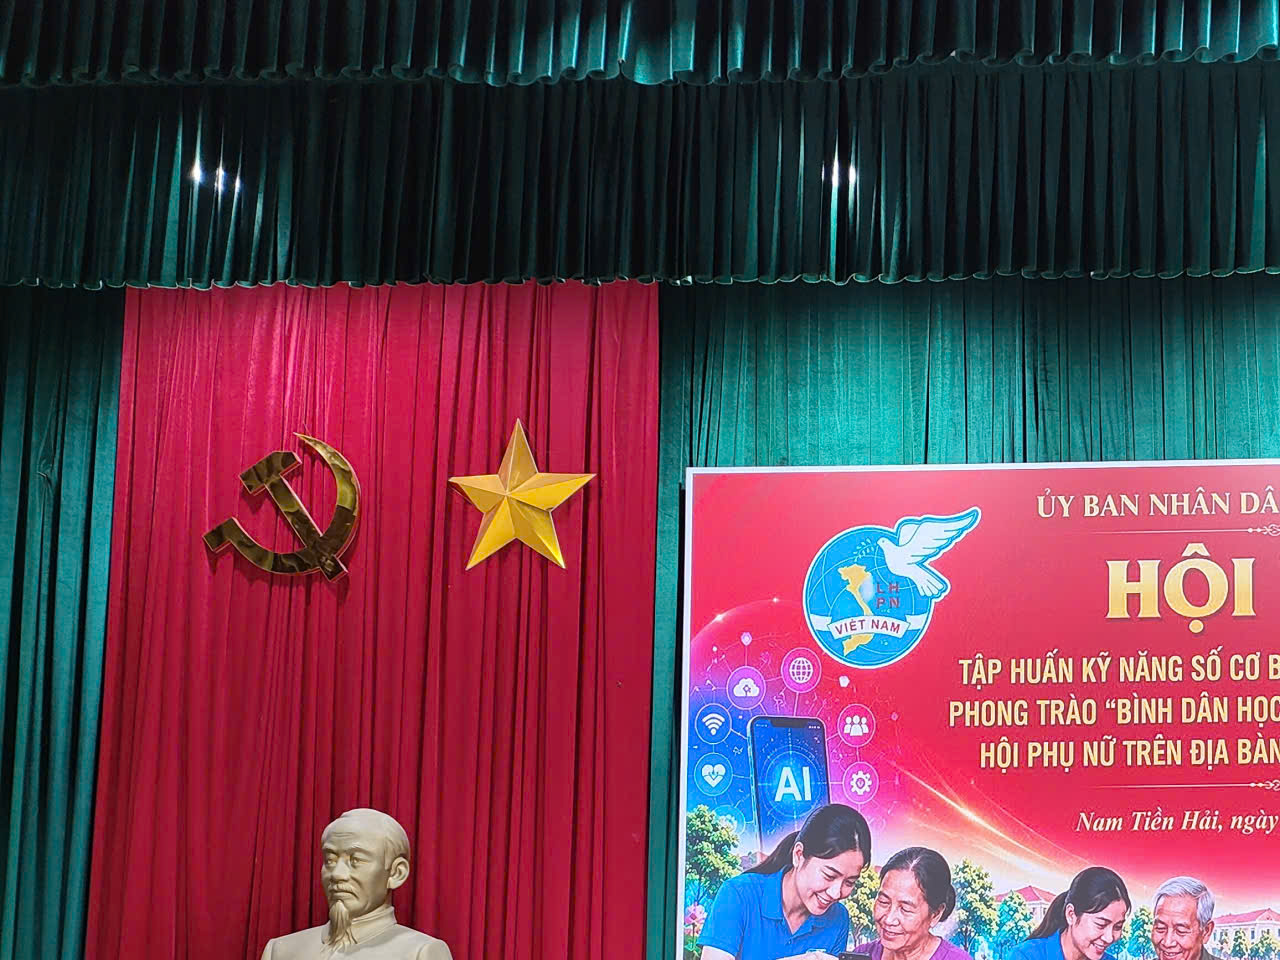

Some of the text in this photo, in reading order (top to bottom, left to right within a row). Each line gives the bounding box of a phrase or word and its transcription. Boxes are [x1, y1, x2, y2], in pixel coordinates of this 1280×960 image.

[1037, 487, 1075, 518] ỦY
[1083, 494, 1140, 517] BAN
[1149, 486, 1231, 516] NHÂN
[1105, 543, 1256, 633] HỘI
[871, 619, 900, 634] NAM
[958, 653, 1002, 690] TẬP
[1010, 648, 1073, 684] HUẤN
[1082, 652, 1112, 683] KỸ
[1119, 650, 1183, 683] NĂNG
[1191, 645, 1223, 682] SỐ
[1229, 652, 1261, 681] CƠ
[949, 699, 1029, 727] PHONG
[1036, 693, 1097, 726] TRÀO
[1105, 692, 1172, 725] “BÌNH
[1181, 691, 1228, 723] DÂN
[980, 736, 1018, 774] HỘI
[1027, 741, 1074, 773] PHỤ
[1083, 735, 1117, 767] NỮ
[1123, 734, 1182, 766] TRÊN
[1190, 738, 1230, 771] ĐỊA
[774, 766, 812, 802] AI
[1075, 811, 1123, 832] Nam
[1131, 806, 1175, 832] Tiền
[1181, 809, 1223, 833] Hải,
[1229, 809, 1279, 835] ngày
